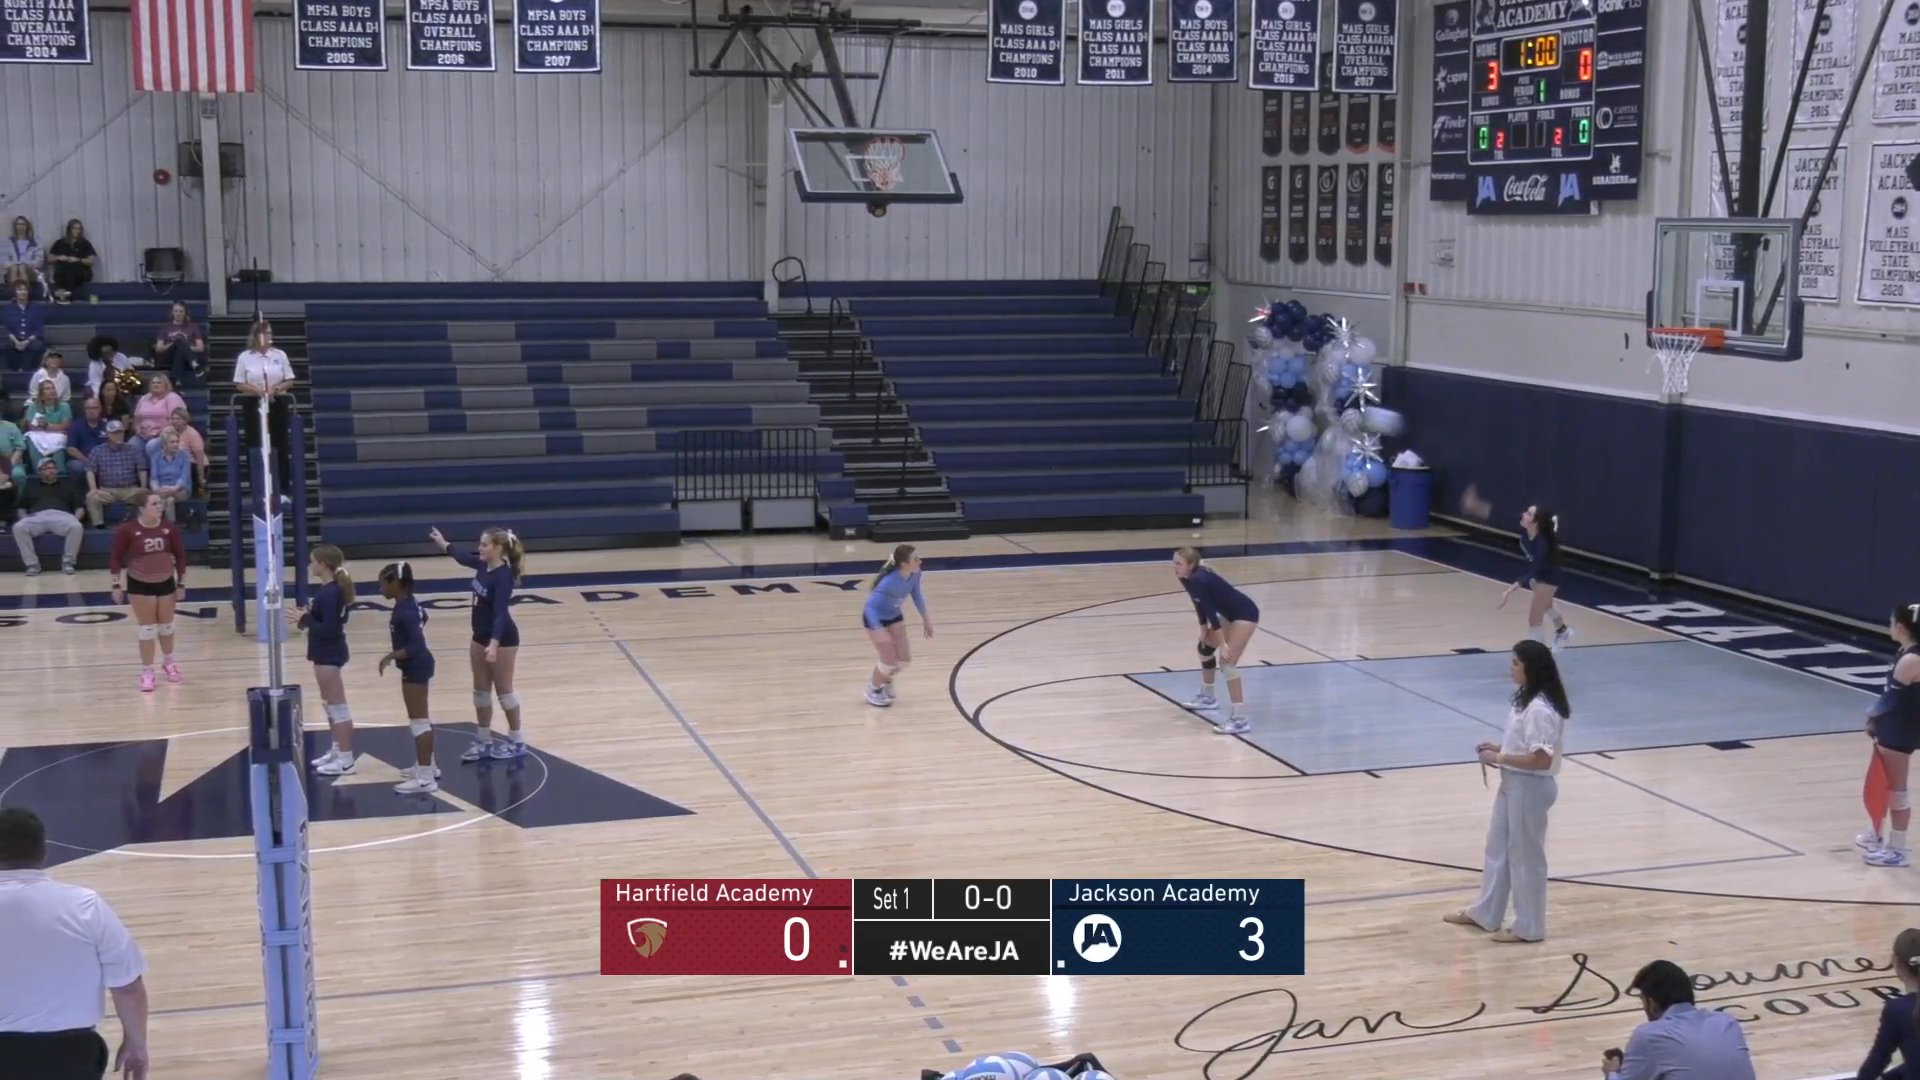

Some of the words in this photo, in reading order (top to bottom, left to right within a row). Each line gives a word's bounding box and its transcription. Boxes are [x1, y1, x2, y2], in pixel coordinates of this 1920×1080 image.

[307, 4, 338, 16] MPSA
[342, 6, 372, 18] BOYS
[420, 0, 449, 10] MPSA
[453, 0, 480, 10] BOYS
[5, 9, 44, 20] CLASS
[48, 10, 74, 22] AAA
[412, 12, 446, 24] CLASS
[449, 13, 472, 24] AAA
[528, 10, 556, 20] MPSA
[559, 10, 586, 20] BOYS
[1497, 1, 1567, 28] ACADEMY
[11, 22, 70, 34] OVERALL
[300, 20, 336, 32] CLASS
[340, 22, 364, 32] AAA
[520, 24, 554, 36] CLASS
[557, 25, 580, 36] AAA
[1000, 24, 1024, 35] MAIS
[1026, 26, 1054, 36] GIRLS
[1089, 19, 1112, 30] MAIS
[1114, 20, 1142, 30] GIRLS
[1180, 20, 1201, 30] MAIS
[1204, 20, 1228, 30] BOYS
[1261, 20, 1284, 30] MAIS
[1285, 20, 1312, 32] GIRLS
[1366, 24, 1390, 35] GIRLS
[424, 26, 476, 38] OVERALL
[1083, 31, 1114, 42] CLASS
[1115, 32, 1136, 42] AAA
[1173, 30, 1200, 40] CLASS
[1201, 31, 1221, 42] AAA
[1255, 30, 1280, 40] CLASS
[1282, 31, 1305, 42] AAAA
[1562, 28, 1594, 46] VISITOR
[7, 34, 76, 46] CHAMPIONS
[308, 36, 372, 48] CHAMPIONS
[994, 38, 1024, 49] CLASS
[1026, 40, 1046, 50] AAA
[1338, 34, 1361, 44] CLASS
[26, 46, 58, 58] 2004
[420, 40, 482, 52] CHAMPIONS
[527, 40, 588, 52] CHAMPIONS
[1088, 44, 1118, 55] CLASS
[1121, 45, 1142, 56] AAA
[1176, 42, 1205, 52] CLASS
[1209, 42, 1229, 52] AAA
[1256, 41, 1286, 52] CLASS
[1287, 42, 1312, 52] AAAA
[1339, 45, 1366, 54] CLASS
[1368, 46, 1391, 56] AAAA
[1476, 42, 1498, 58] HOME
[326, 52, 355, 64] 2005
[438, 54, 465, 64] 2006
[544, 56, 571, 66] 2007
[999, 52, 1054, 65] CHAMPIONS
[1089, 56, 1142, 68] CHAMPIONS
[1176, 53, 1230, 64] CHAMPIONS
[1264, 52, 1306, 63] OVERALL
[1344, 56, 1385, 66] OVERALL
[1192, 64, 1212, 74] 2014
[1259, 62, 1310, 74] CHAMPIONS
[1579, 48, 1593, 81] 0
[1014, 68, 1038, 78] 2010
[1105, 69, 1126, 79] 2011
[1341, 66, 1388, 77] CHAMPIONS
[1487, 60, 1498, 91] 3
[1354, 76, 1374, 87] 2017
[1810, 73, 1834, 86] STATE
[1886, 226, 1909, 240] MAIS
[1869, 240, 1920, 254] VOLLEYBAL
[1881, 255, 1909, 268] STATE
[1881, 284, 1904, 297] 2020
[144, 538, 164, 552] 20
[1597, 601, 1893, 685] RAID
[1714, 985, 1903, 1023] COUR
